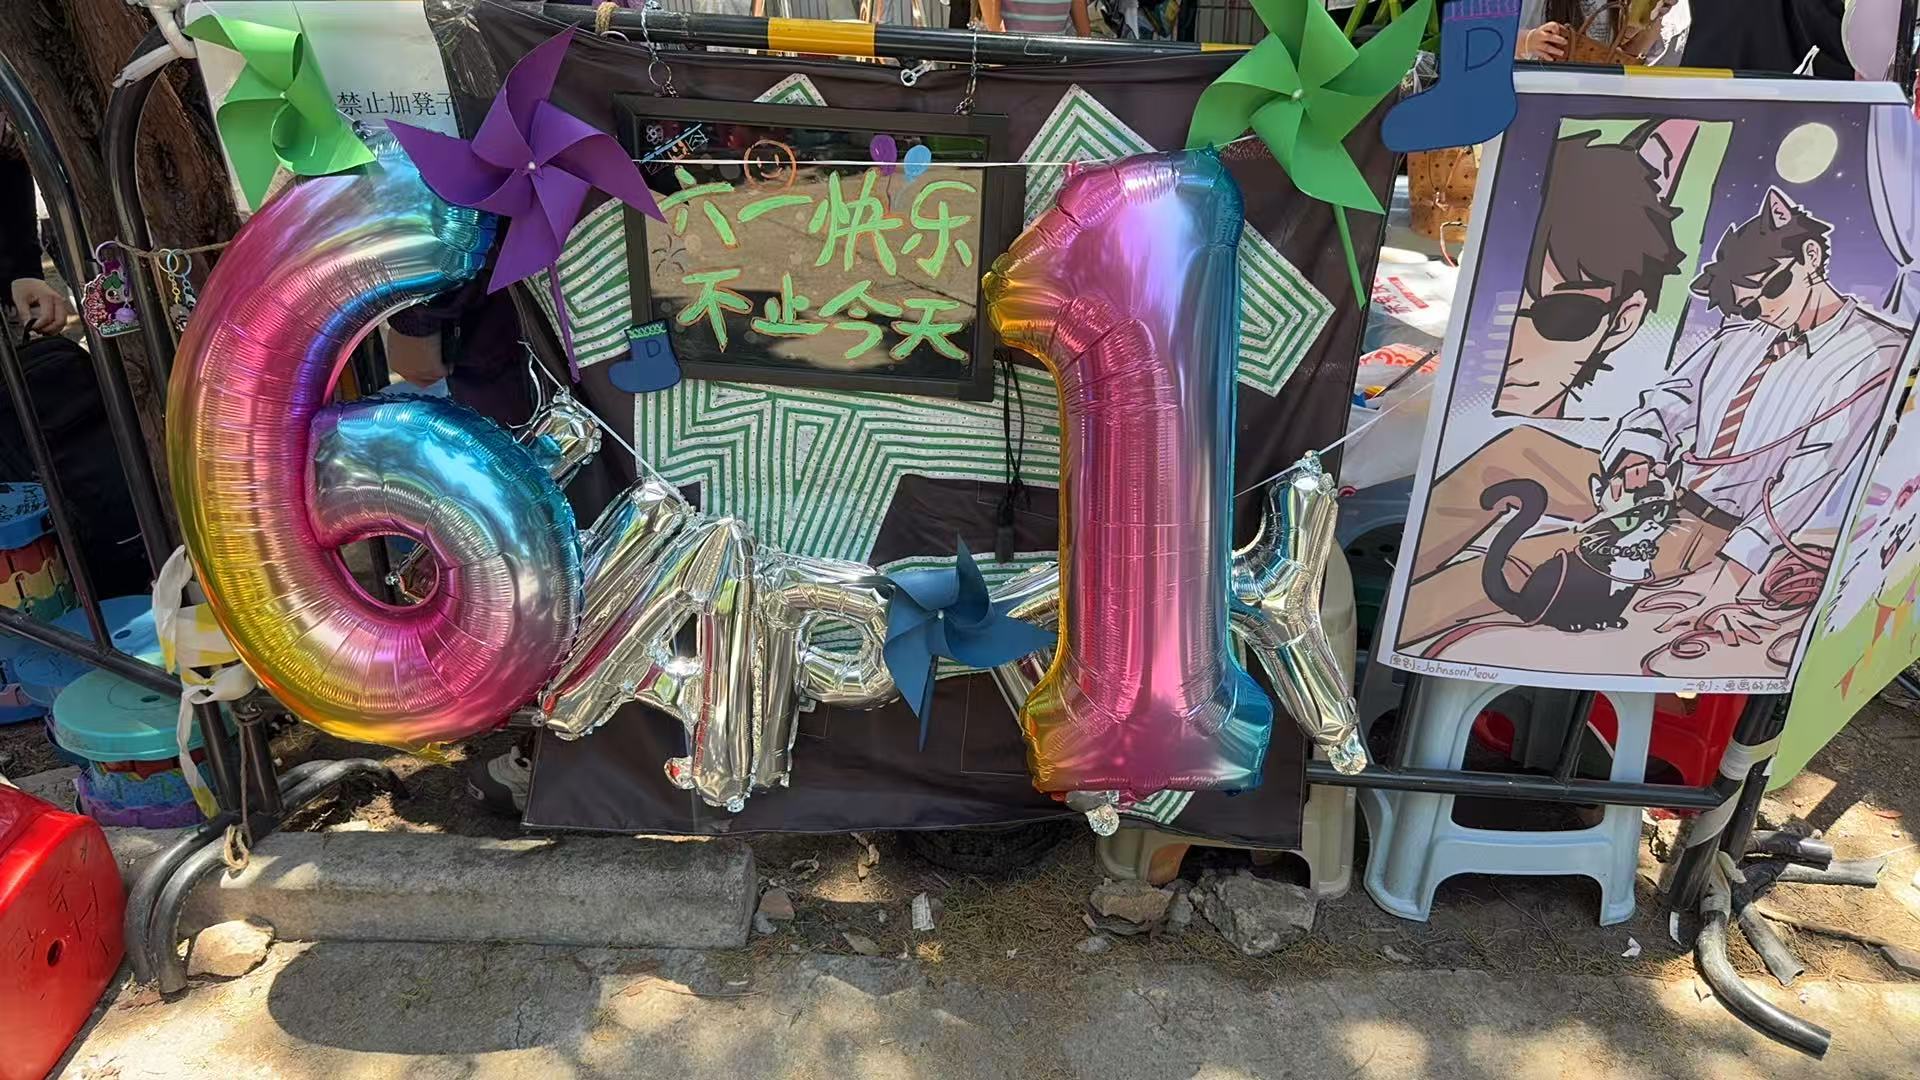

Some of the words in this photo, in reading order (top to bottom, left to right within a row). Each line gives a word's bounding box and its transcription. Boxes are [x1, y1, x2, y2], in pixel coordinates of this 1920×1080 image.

[1464, 26, 1505, 73] D
[656, 165, 977, 280] 六一快乐
[645, 338, 662, 359] D
[675, 268, 971, 362] 不止今天
[164, 132, 582, 762] 6
[983, 148, 1272, 795] 1
